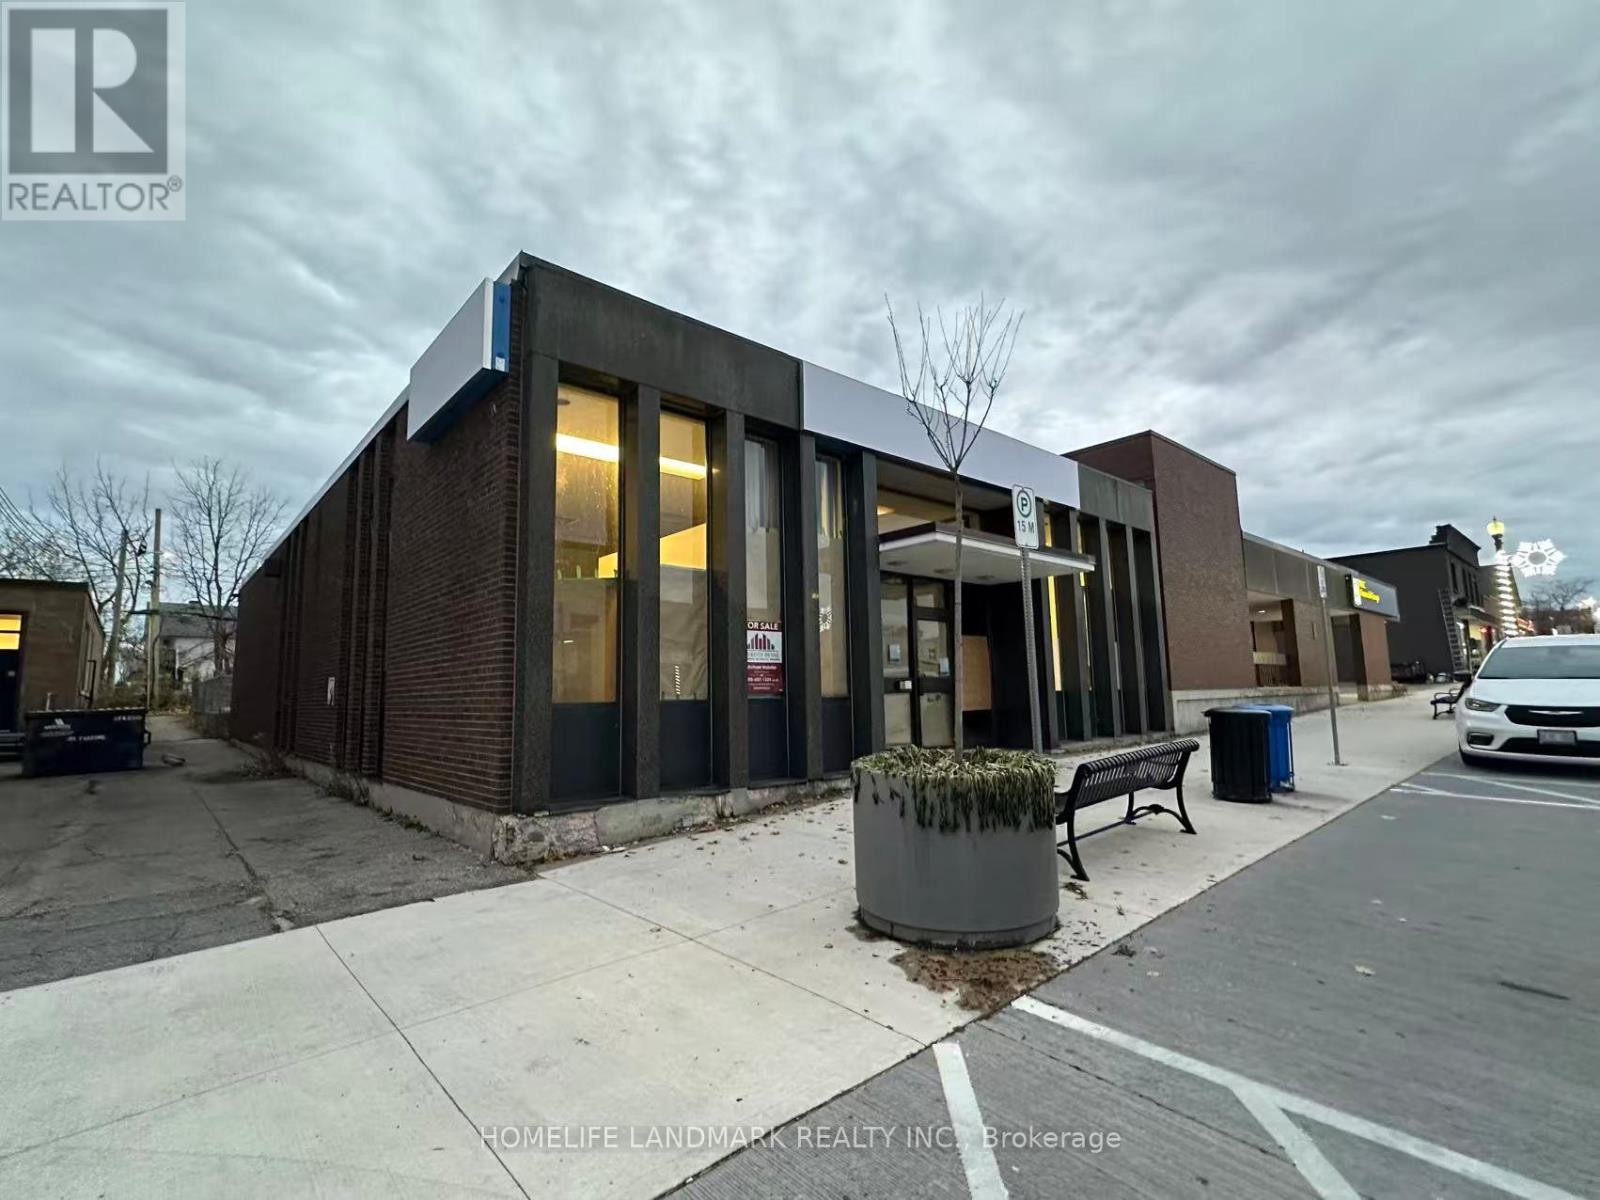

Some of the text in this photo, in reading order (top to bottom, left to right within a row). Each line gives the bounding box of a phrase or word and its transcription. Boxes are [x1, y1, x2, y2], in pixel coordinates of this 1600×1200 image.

[1021, 497, 1028, 511] P
[1017, 520, 1035, 534] 15 M
[747, 621, 779, 630] OR SALE
